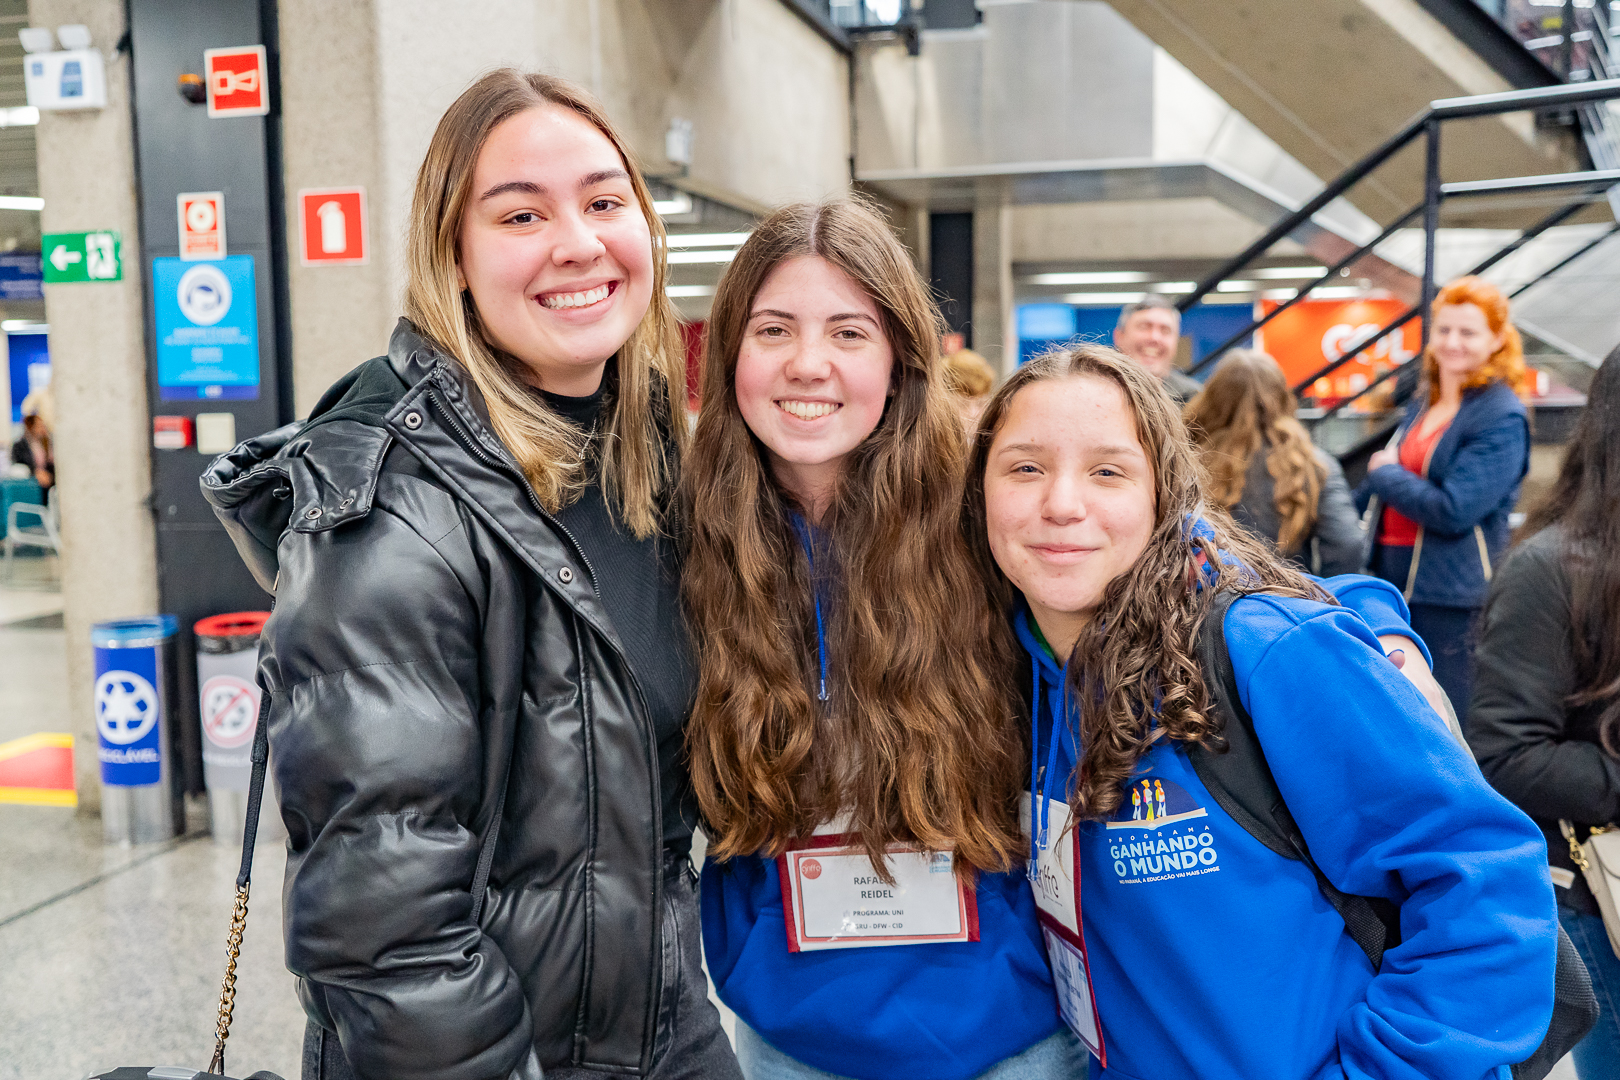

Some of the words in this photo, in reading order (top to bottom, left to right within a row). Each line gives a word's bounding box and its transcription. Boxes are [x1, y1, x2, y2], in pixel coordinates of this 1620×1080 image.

[1109, 825, 1209, 843] PROGRAMA
[1110, 832, 1214, 860] GANHANDO
[1114, 860, 1127, 877] O
[1130, 847, 1217, 876] MUNDO
[1147, 873, 1175, 882] EDUCAÇÃO
[1200, 866, 1220, 874] LONGE
[861, 890, 893, 898] REIDEL
